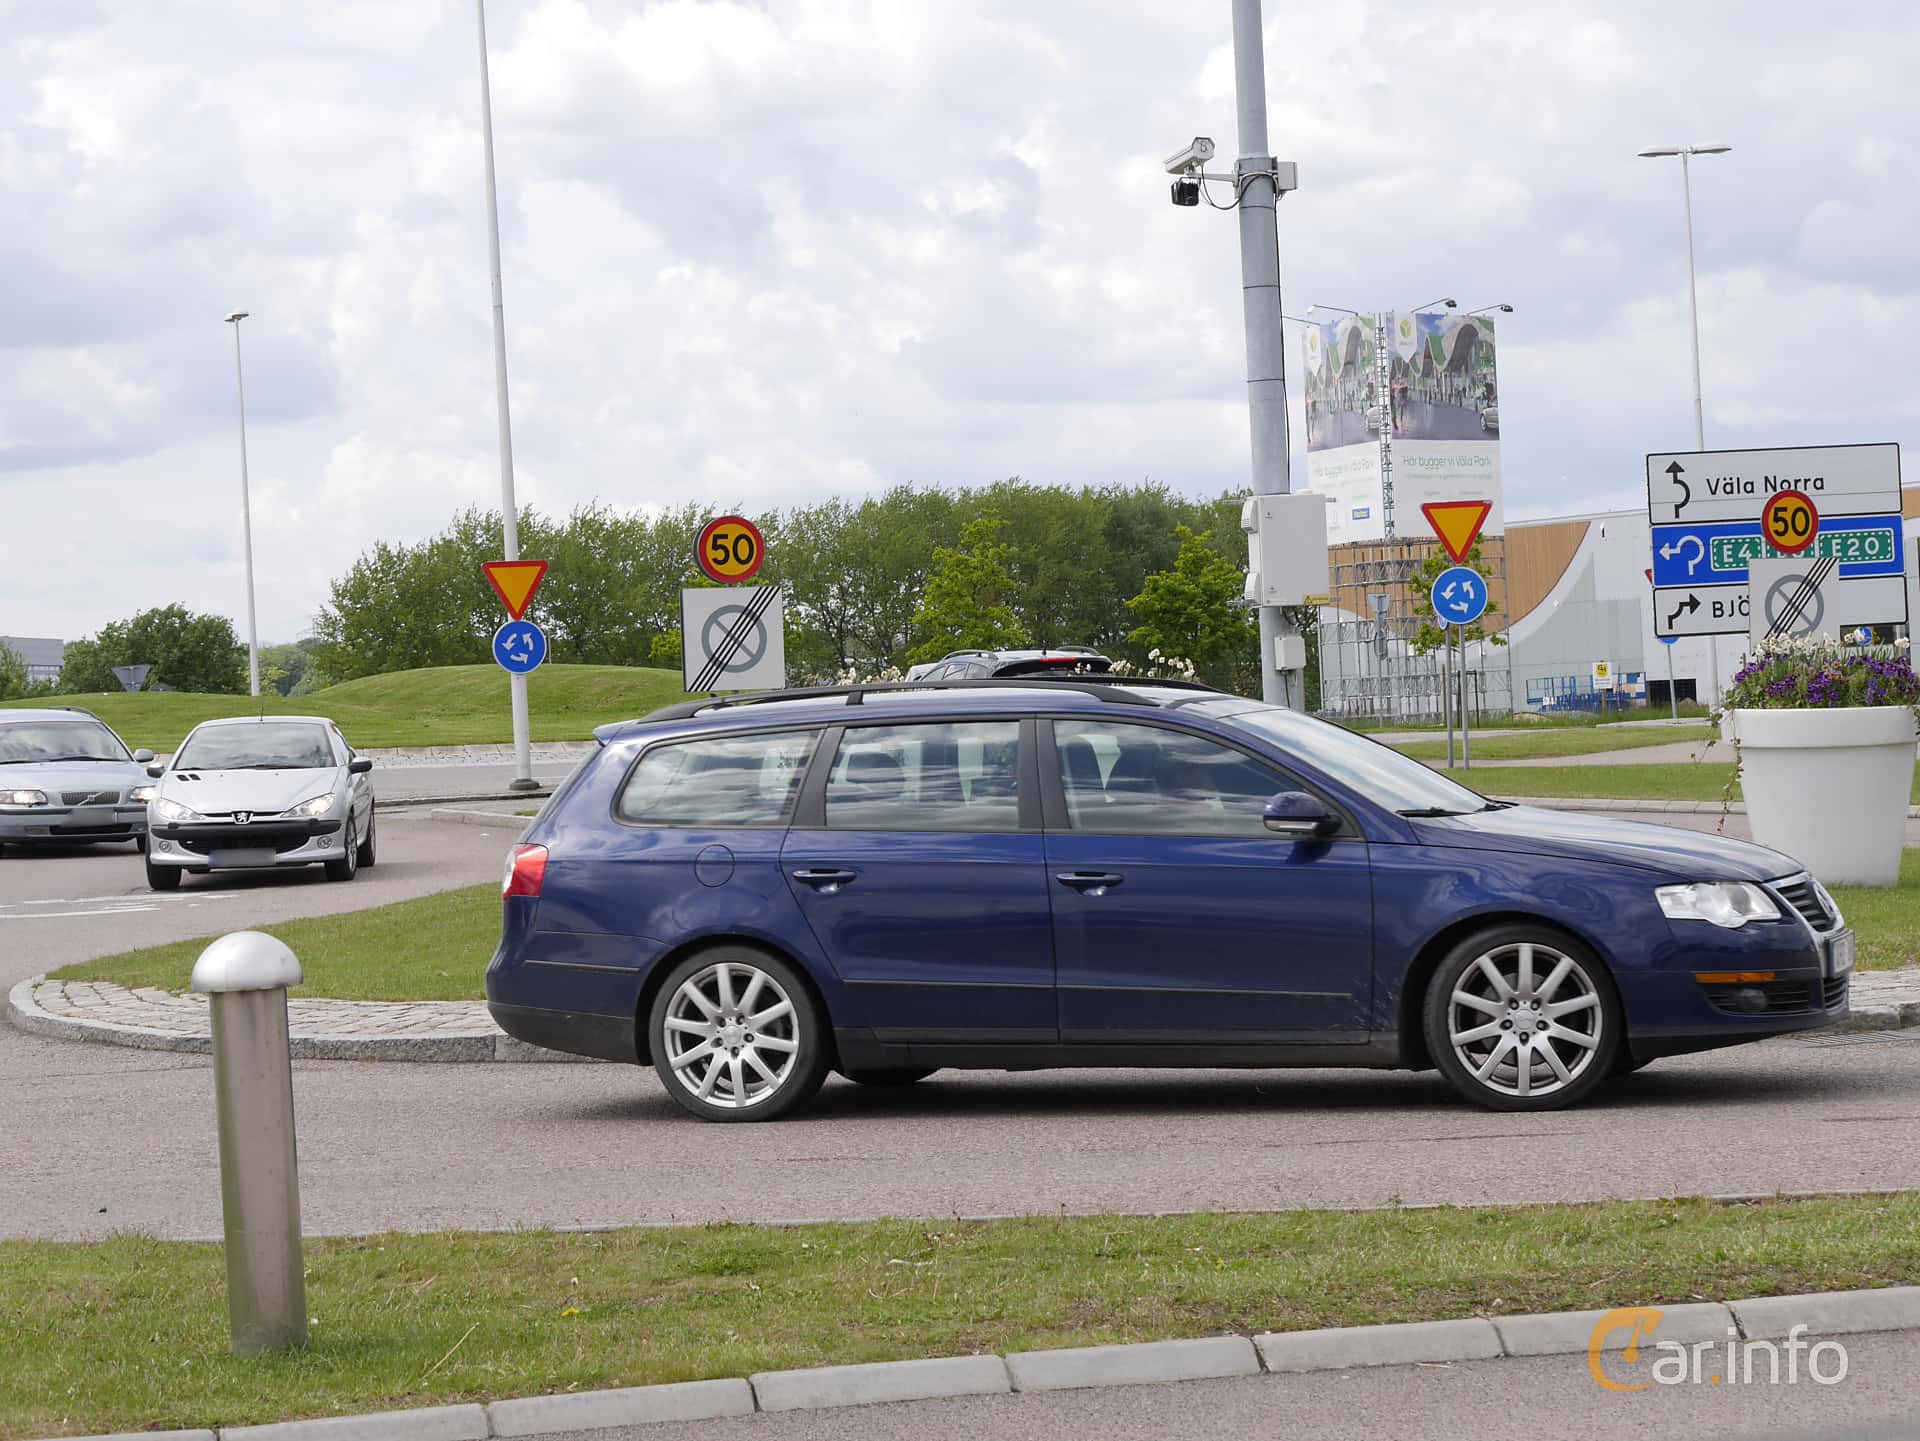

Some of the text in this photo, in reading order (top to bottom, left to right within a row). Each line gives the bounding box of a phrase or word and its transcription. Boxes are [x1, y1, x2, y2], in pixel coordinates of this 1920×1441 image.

[1706, 475, 1825, 496] Väla Norra
[1773, 507, 1811, 537] 50
[711, 533, 755, 566] 50
[1723, 537, 1880, 563] E4 E20
